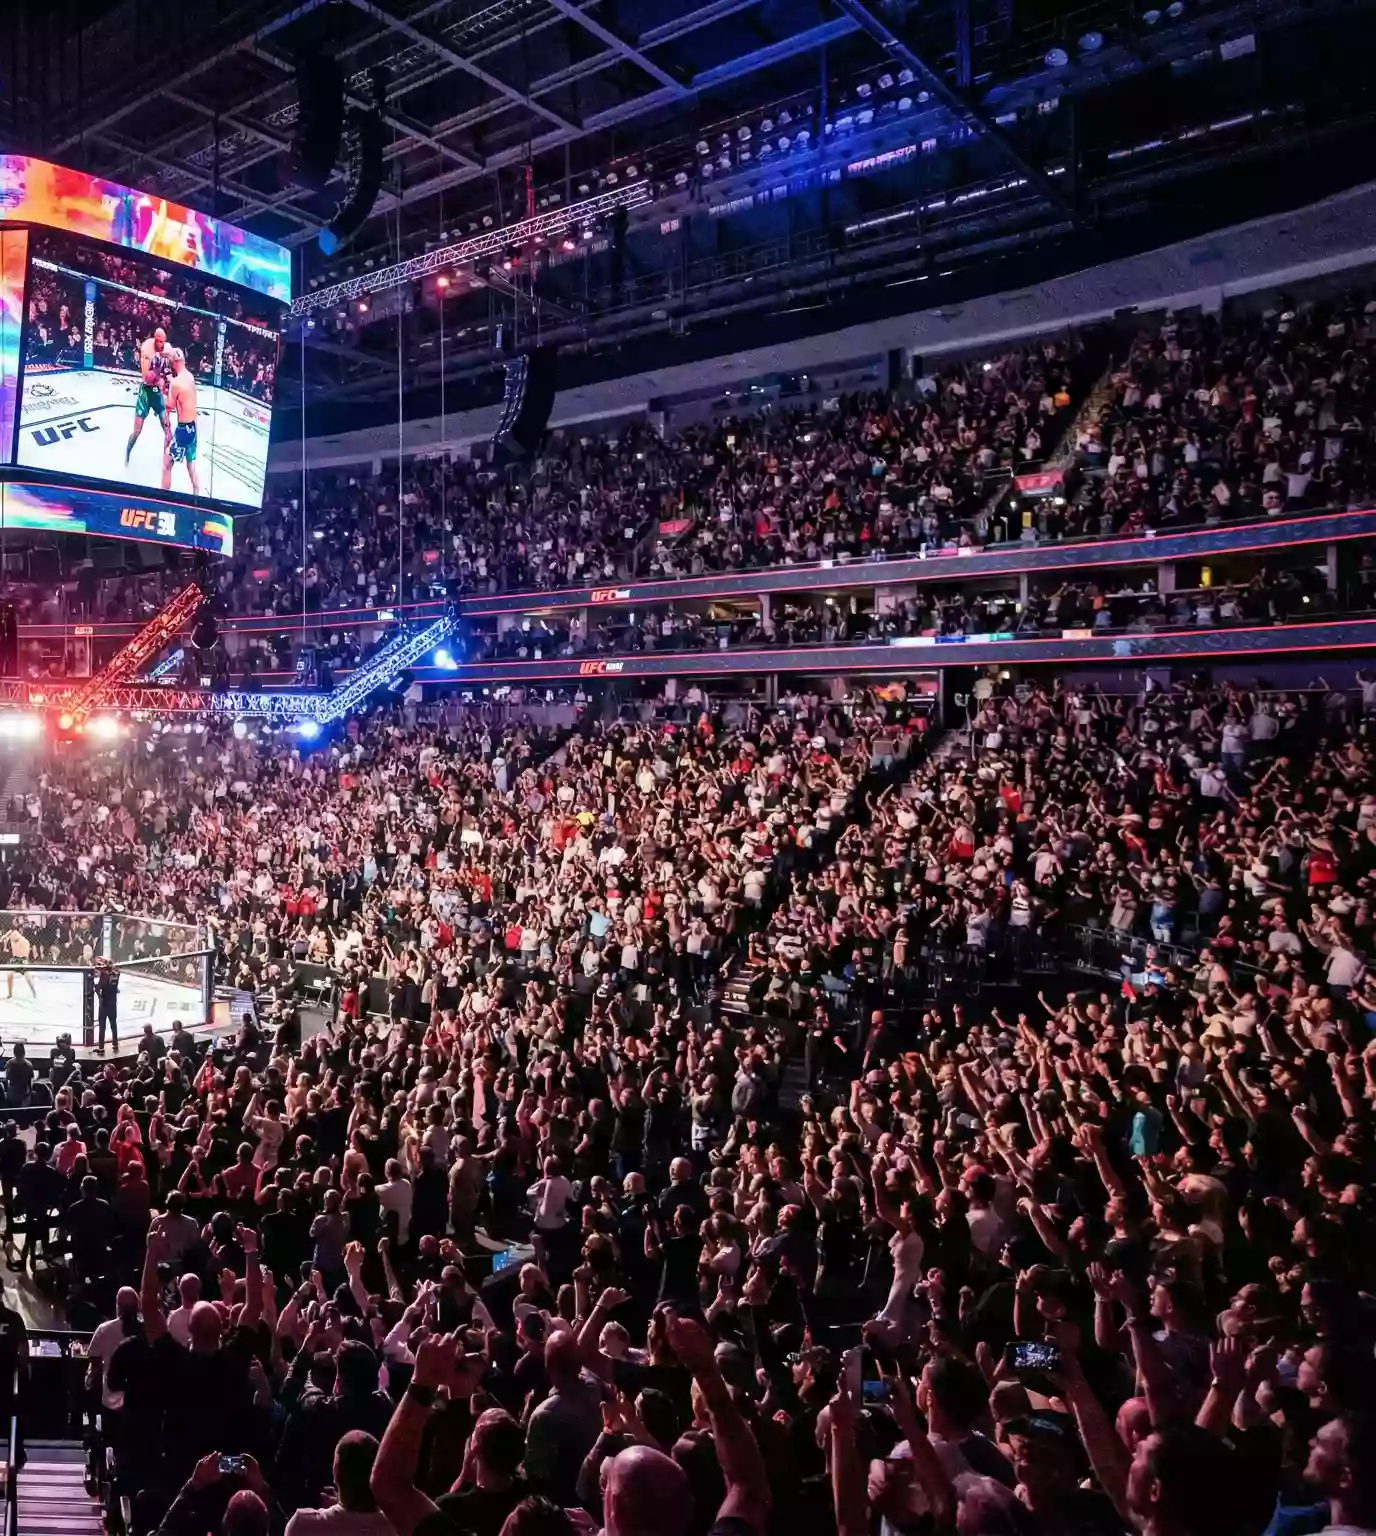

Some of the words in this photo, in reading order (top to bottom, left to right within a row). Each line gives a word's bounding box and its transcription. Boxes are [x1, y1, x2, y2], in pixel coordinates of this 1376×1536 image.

[31, 417, 101, 447] UFC
[120, 508, 157, 530] UFC
[579, 661, 606, 674] UFC
